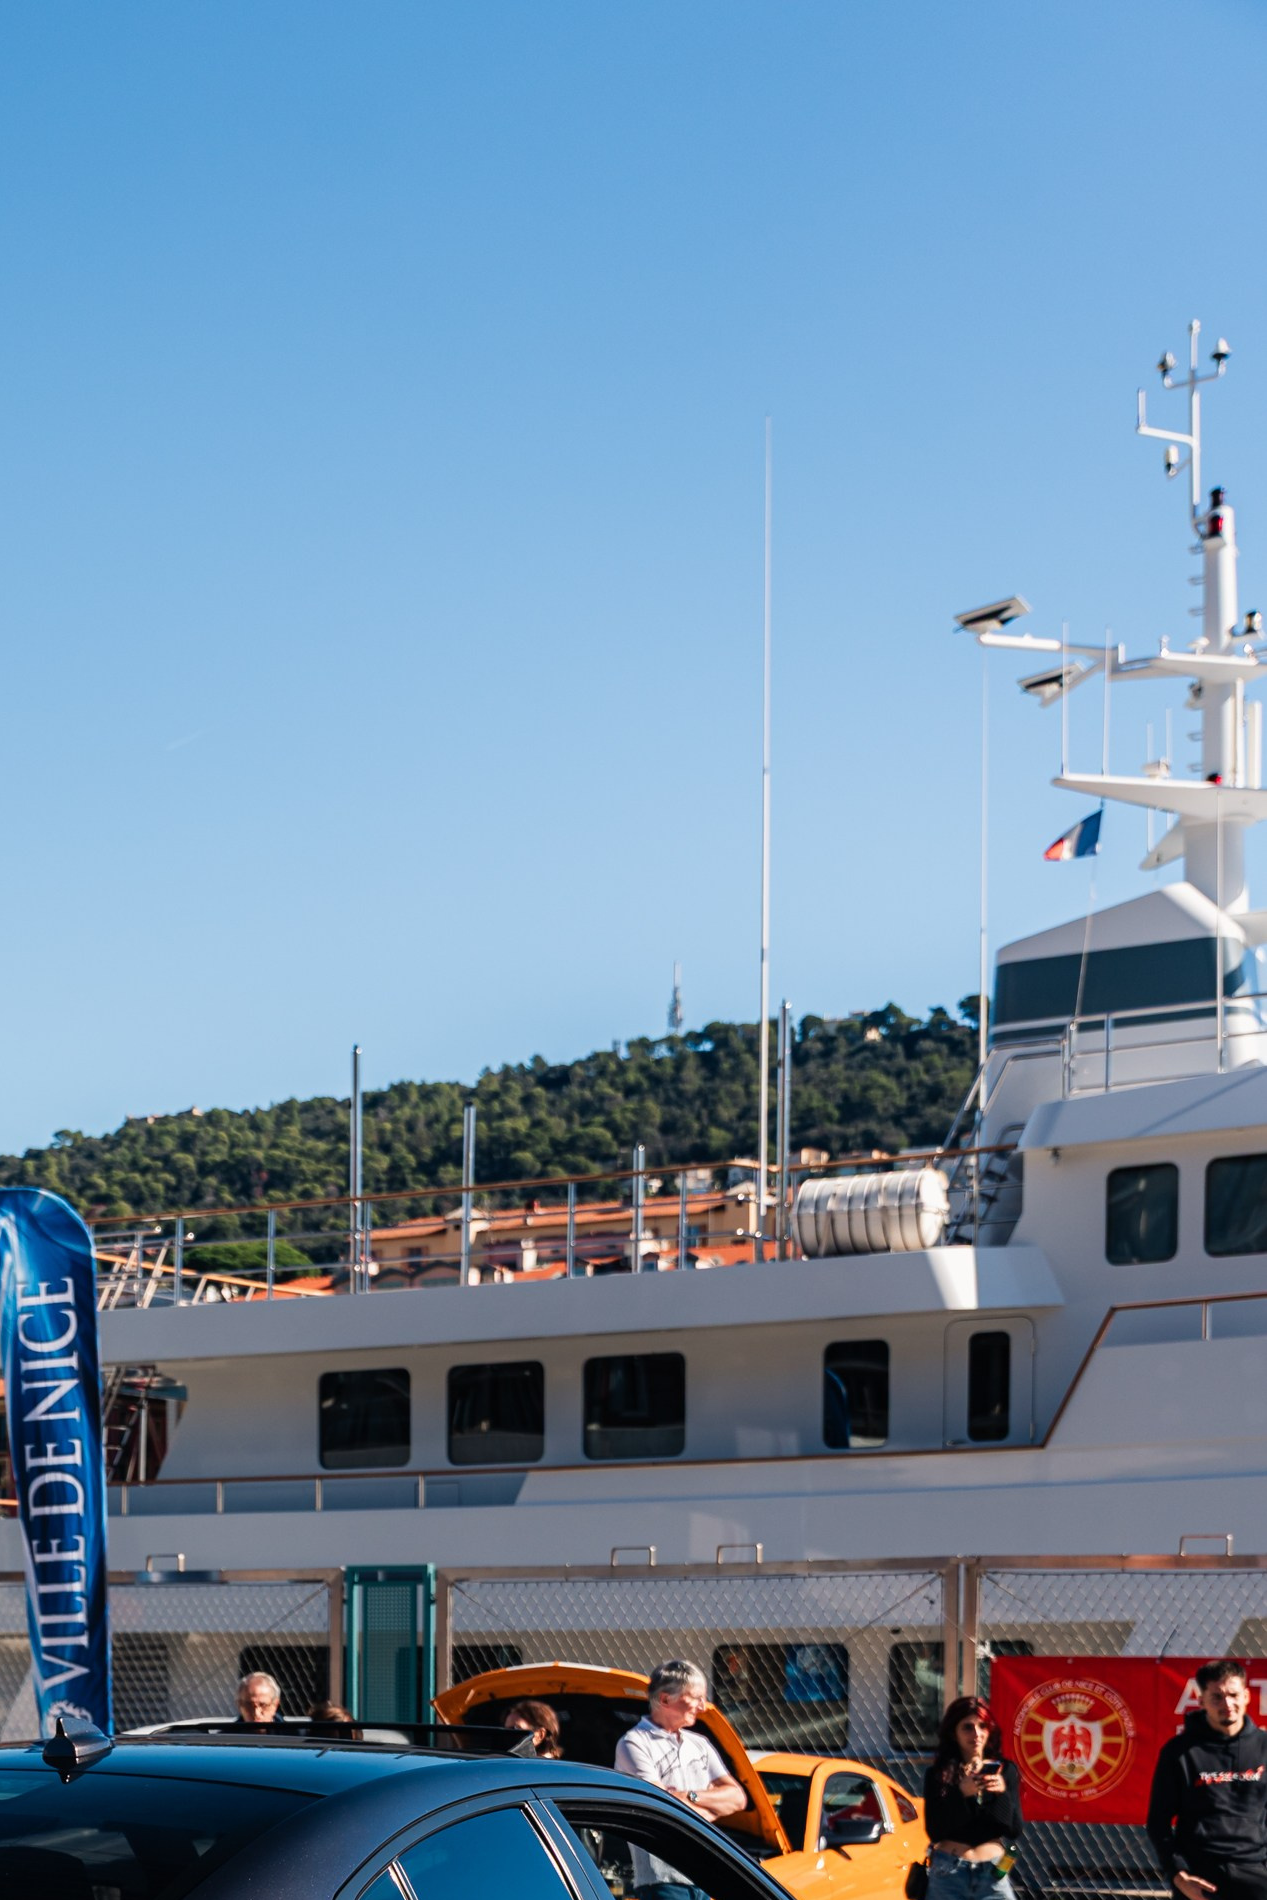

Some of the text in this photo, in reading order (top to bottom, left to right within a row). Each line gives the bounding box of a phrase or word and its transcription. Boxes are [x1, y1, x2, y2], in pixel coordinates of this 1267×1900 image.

[16, 1276, 90, 1691] VILLE DE NICE
